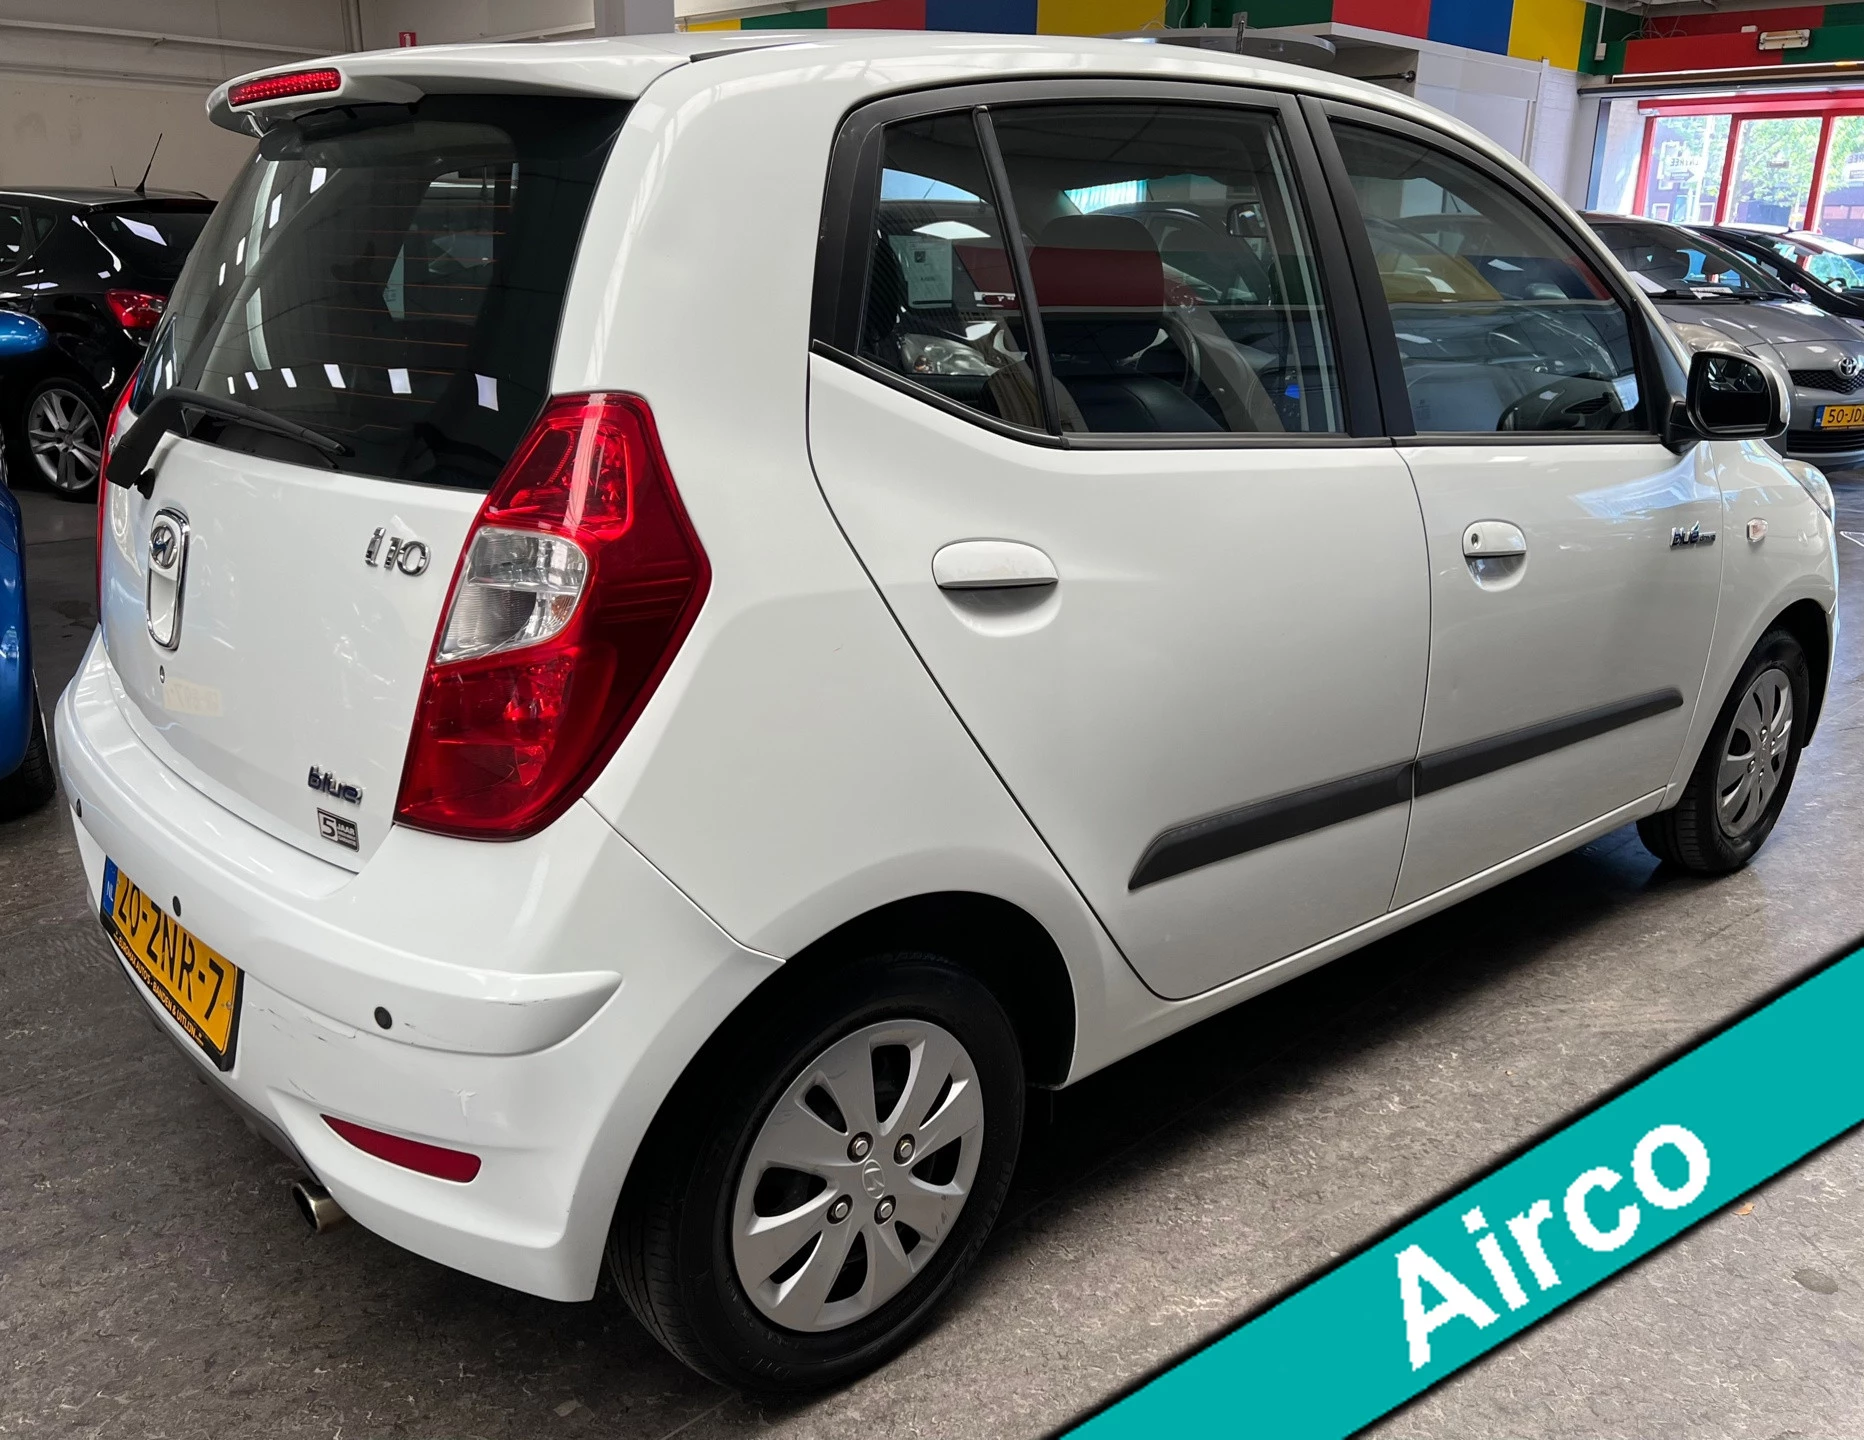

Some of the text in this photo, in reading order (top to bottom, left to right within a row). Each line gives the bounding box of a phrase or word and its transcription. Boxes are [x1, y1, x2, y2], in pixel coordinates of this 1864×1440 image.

[307, 765, 363, 806] blue
[322, 817, 335, 837] 5
[106, 880, 114, 902] NL
